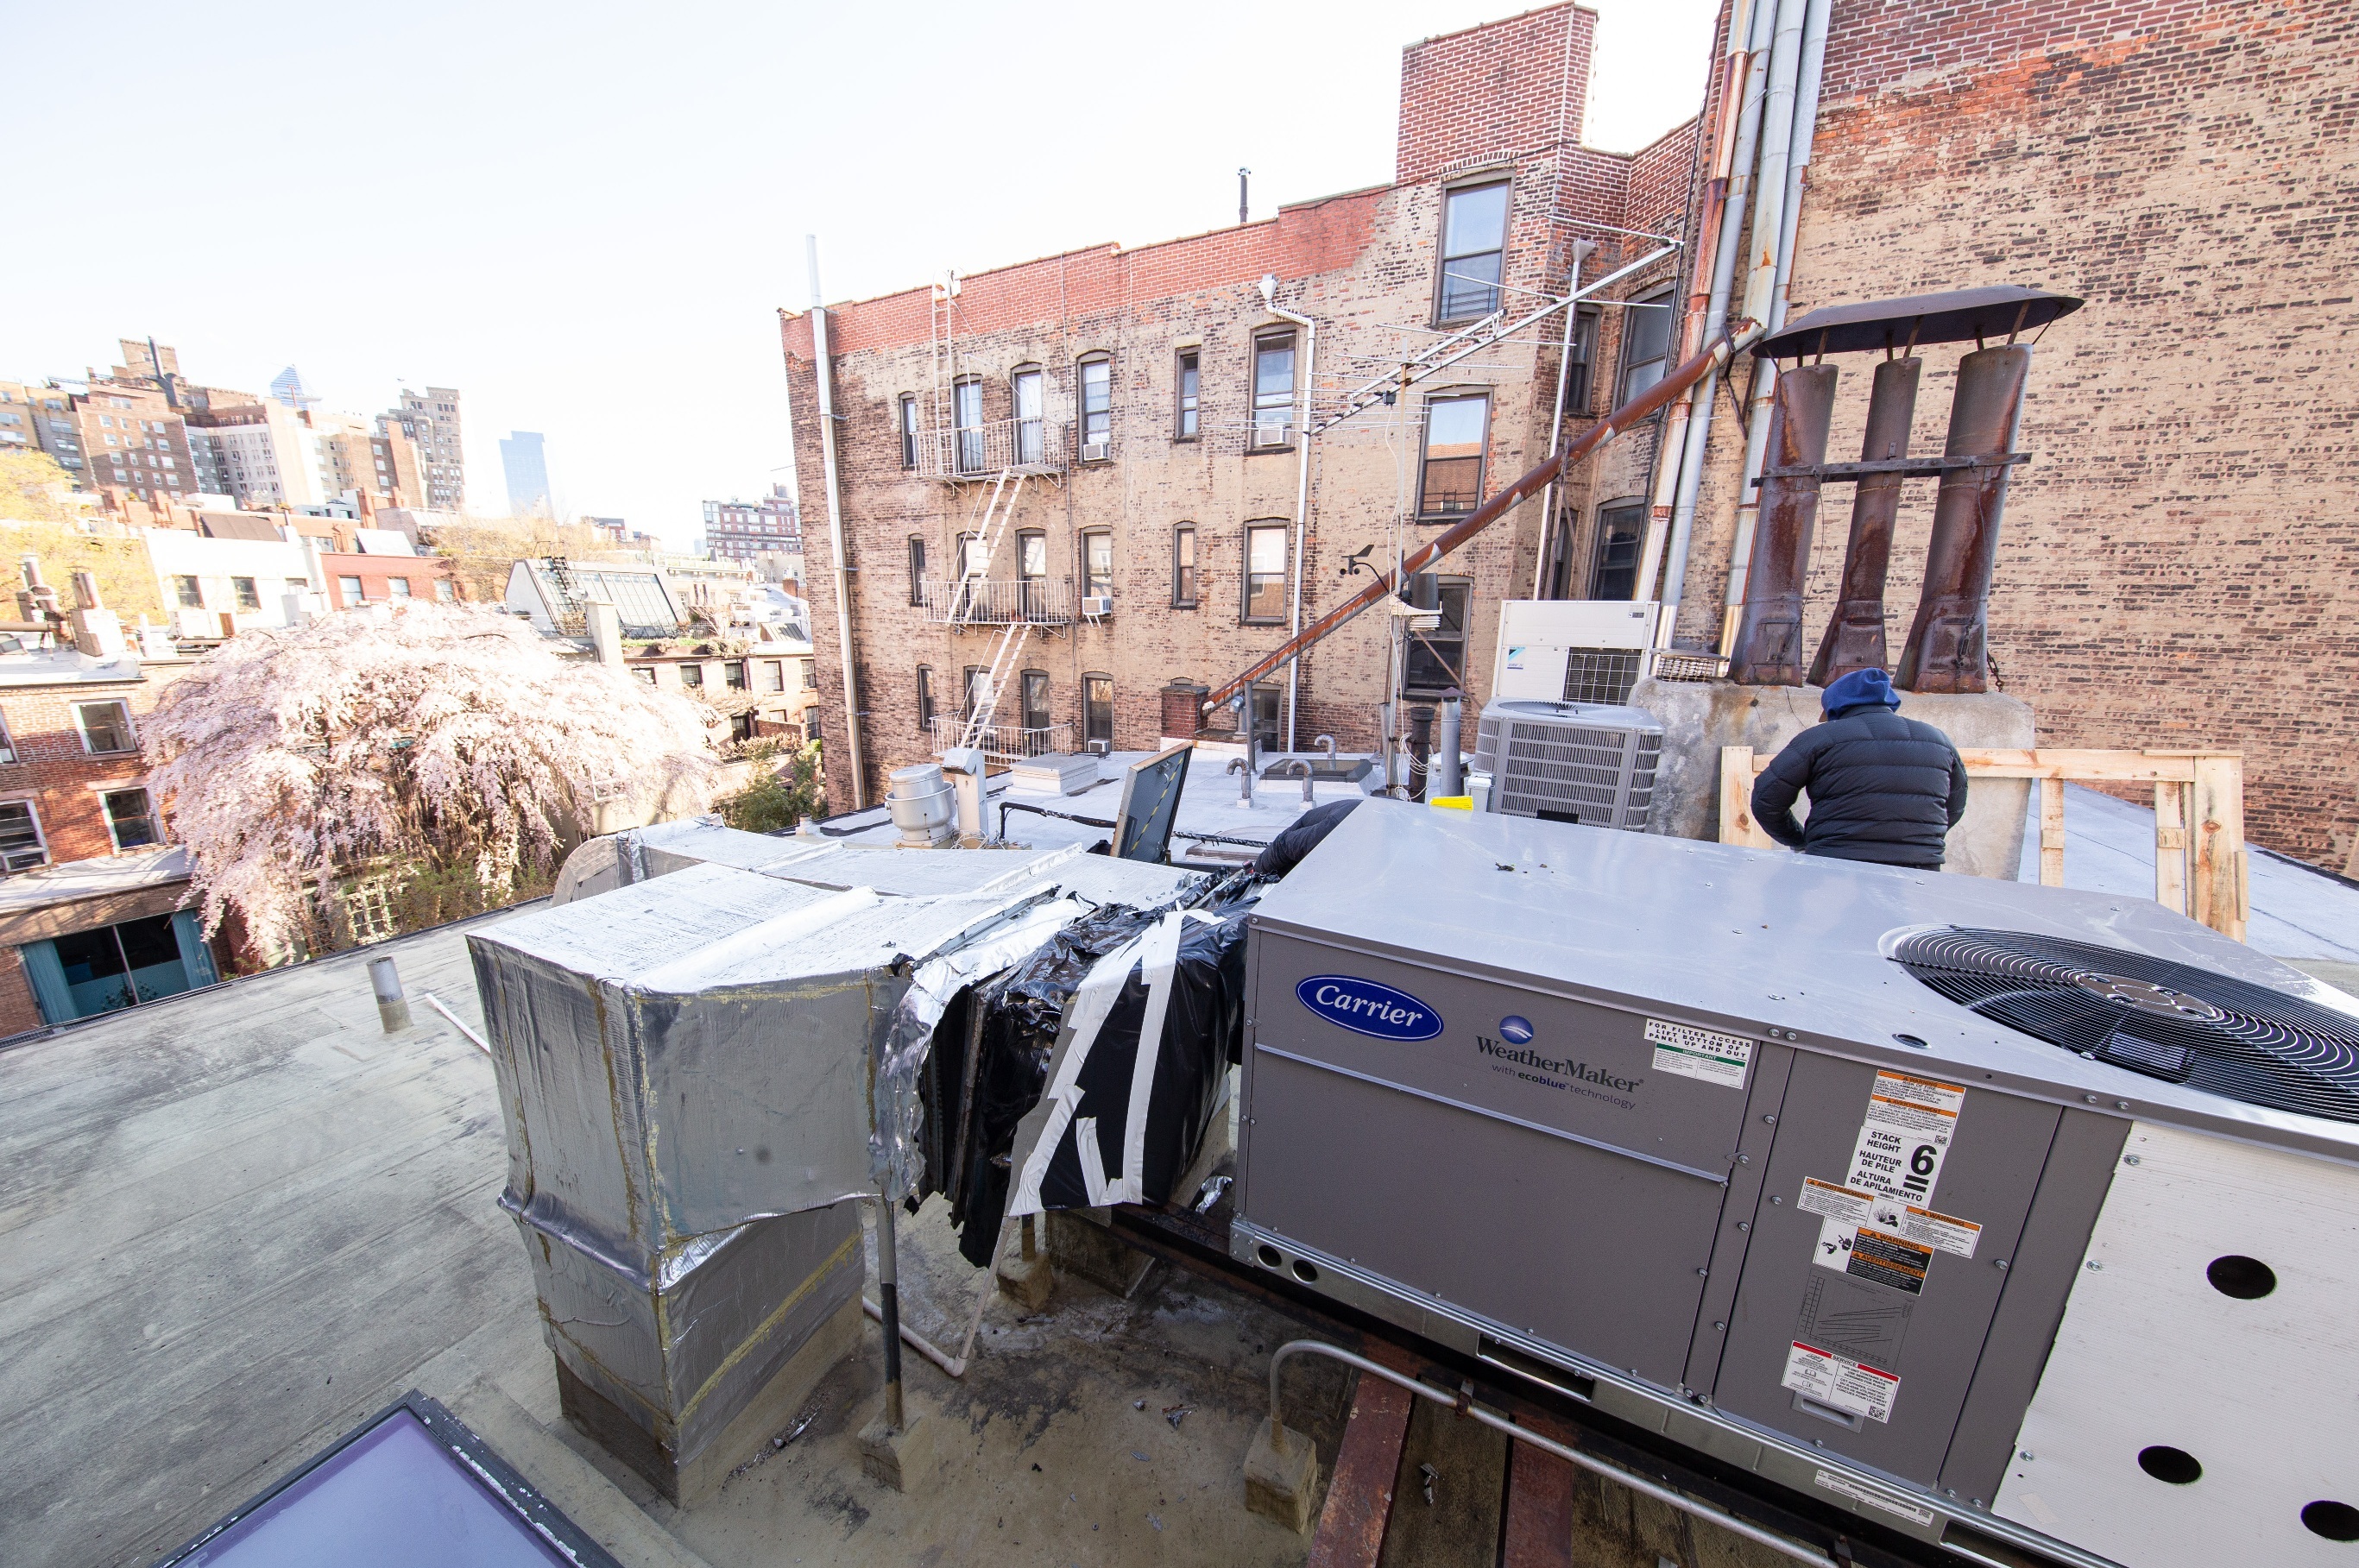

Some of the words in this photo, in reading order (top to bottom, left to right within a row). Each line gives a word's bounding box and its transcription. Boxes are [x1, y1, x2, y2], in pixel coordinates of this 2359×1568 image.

[1315, 985, 1422, 1027] Carrier
[1649, 1033, 1679, 1043] PANEL
[1656, 1029, 1677, 1037] LIFT
[1683, 1035, 1723, 1048] BOTTOM
[1672, 1027, 1706, 1038] FILTER
[1712, 1036, 1750, 1047] ACCESS
[1682, 1049, 1717, 1061] IMPORTANT
[1492, 1064, 1516, 1076] with
[1570, 1084, 1636, 1110] technology
[1908, 1076, 1938, 1086] WARNING
[1892, 1099, 1940, 1113] AVERTISSEMENT
[1871, 1131, 1902, 1144] STACK
[1866, 1139, 1901, 1153] HEIGHT
[1859, 1150, 1902, 1167] HAUTEUR
[1910, 1144, 1937, 1175] 6
[1875, 1162, 1895, 1173] PILE
[1857, 1170, 1891, 1185] ALTURA
[1817, 1181, 1870, 1200] AVERTISSEMENT
[1864, 1181, 1922, 1202] APILAMIENTO
[1928, 1212, 1965, 1226] WARNING
[1879, 1234, 1920, 1250] WARNING
[1861, 1254, 1921, 1276] AVERTISSEMENT
[1832, 1355, 1857, 1367] SERVICE
